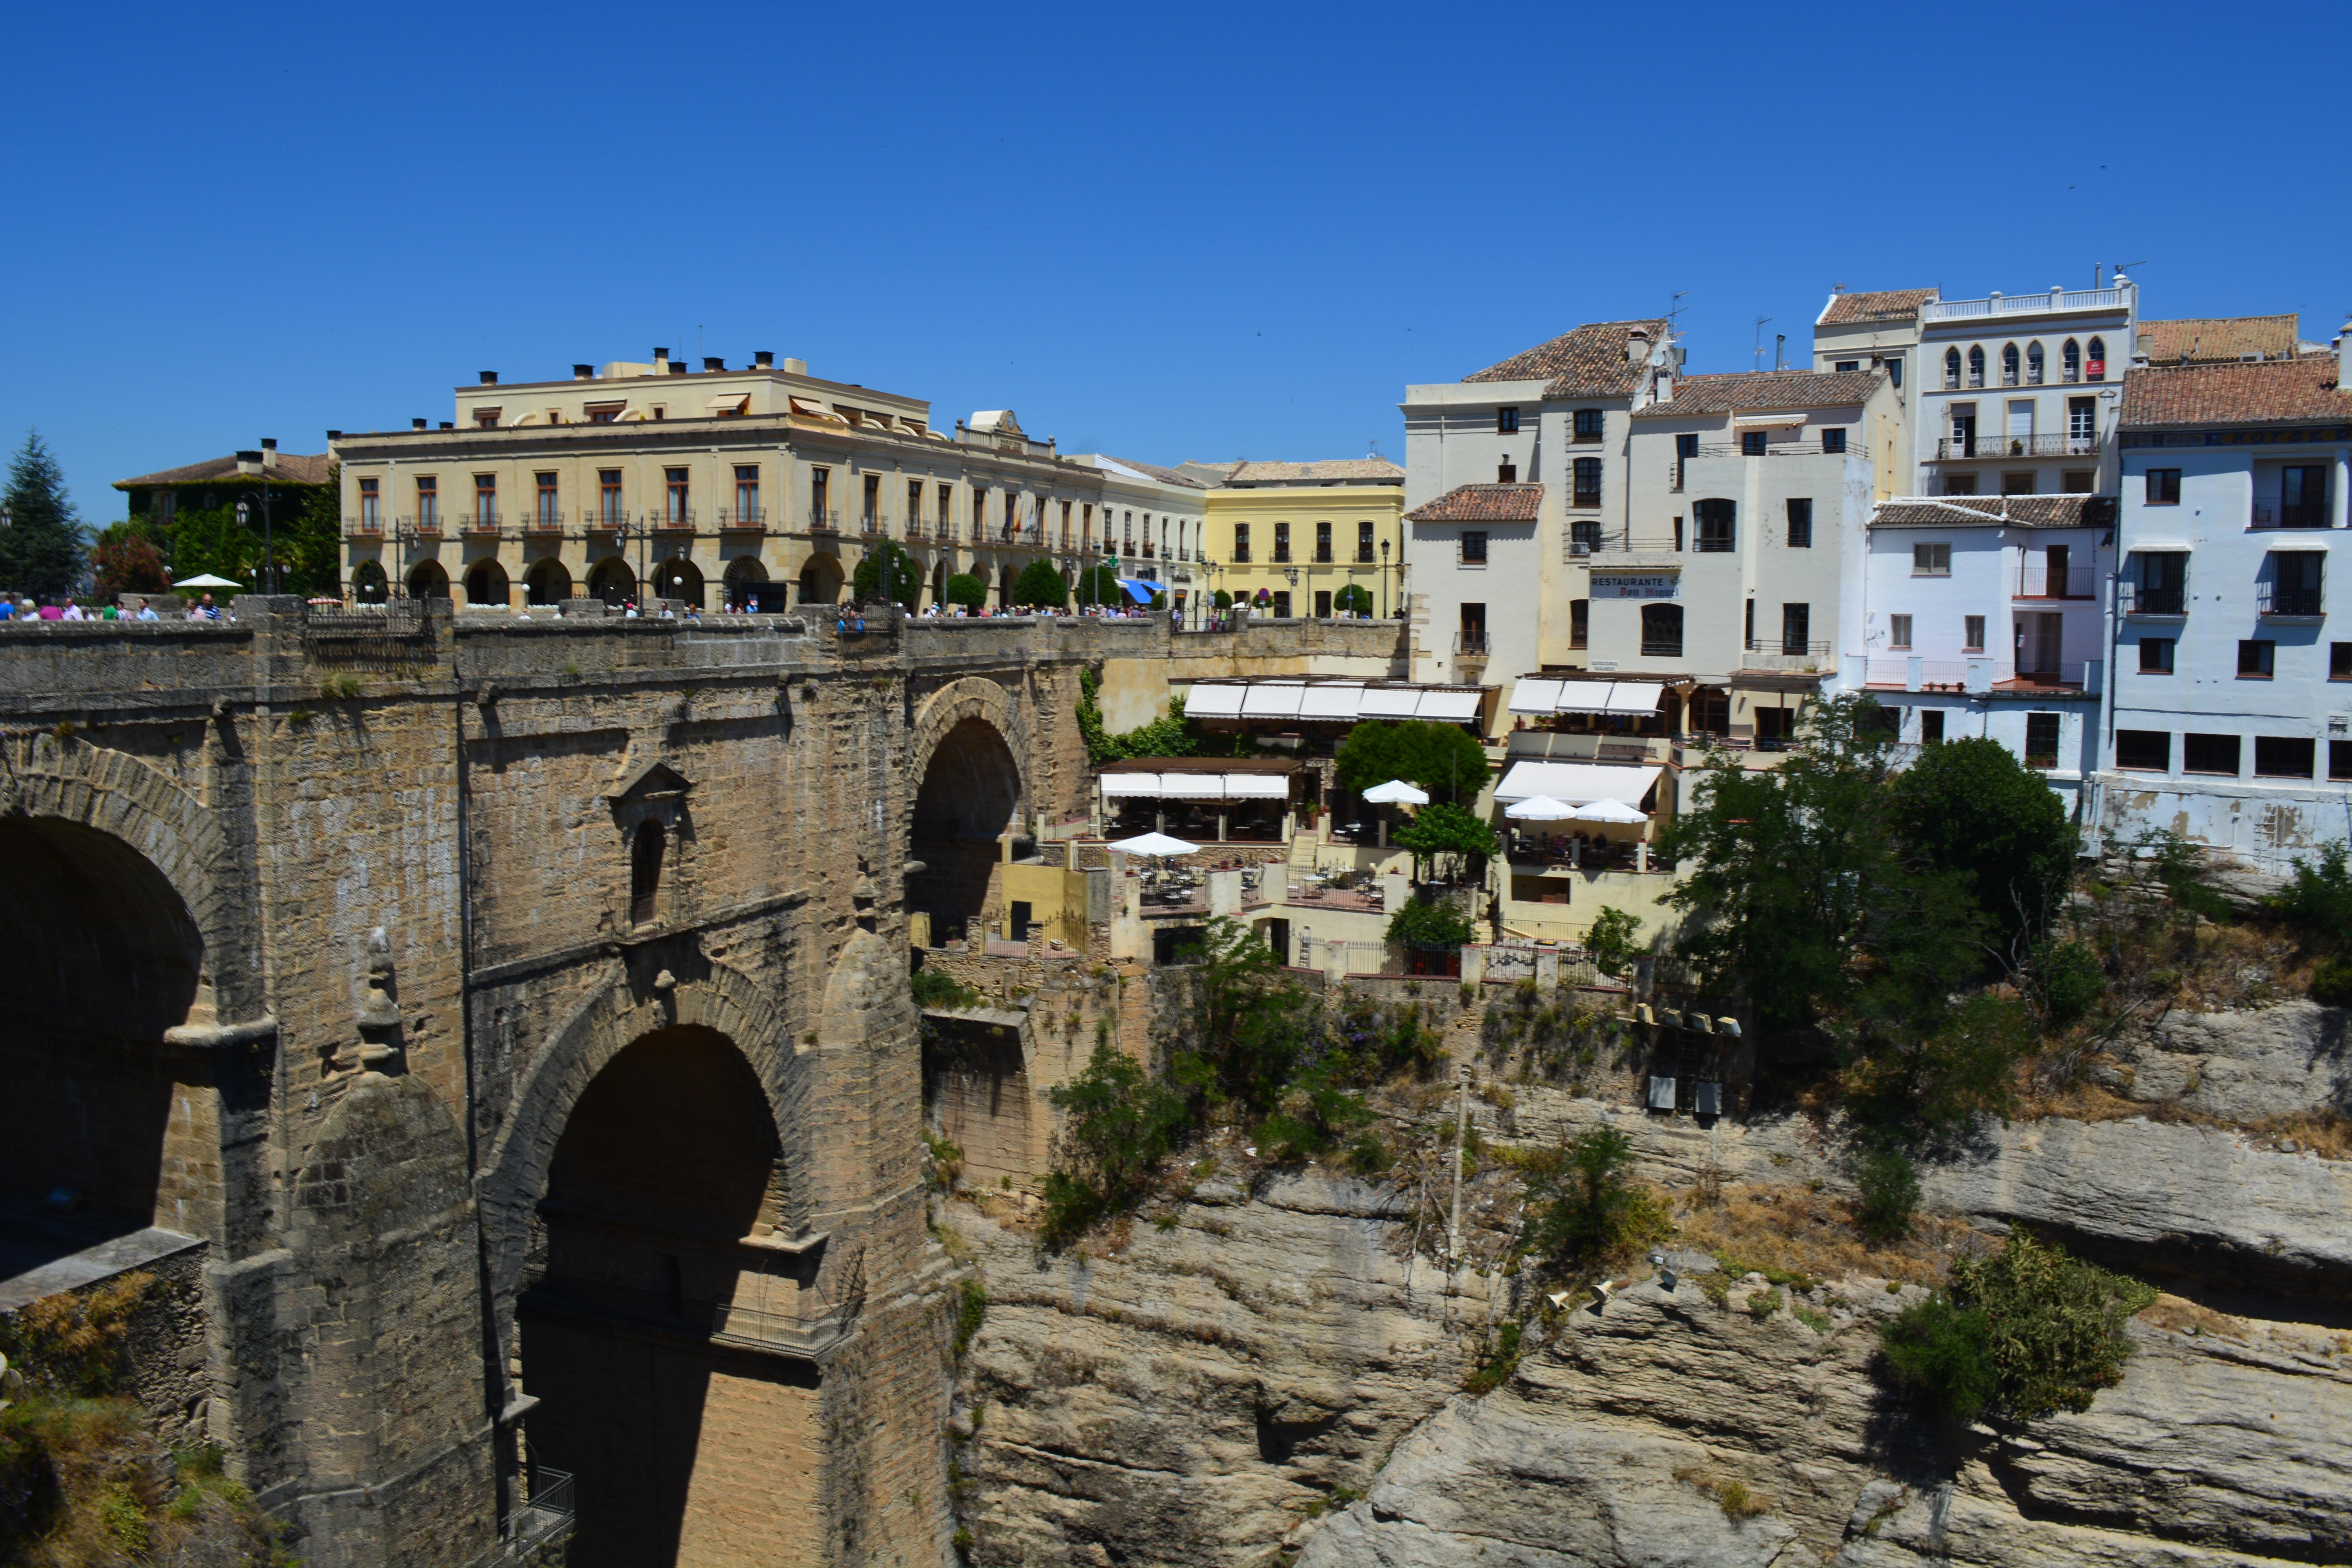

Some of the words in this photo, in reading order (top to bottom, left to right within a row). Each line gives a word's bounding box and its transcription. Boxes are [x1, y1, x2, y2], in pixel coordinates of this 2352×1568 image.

[1592, 578, 1663, 586] RESTAURANTE
[1620, 587, 1639, 596] Don
[1645, 588, 1679, 598] Miguel
